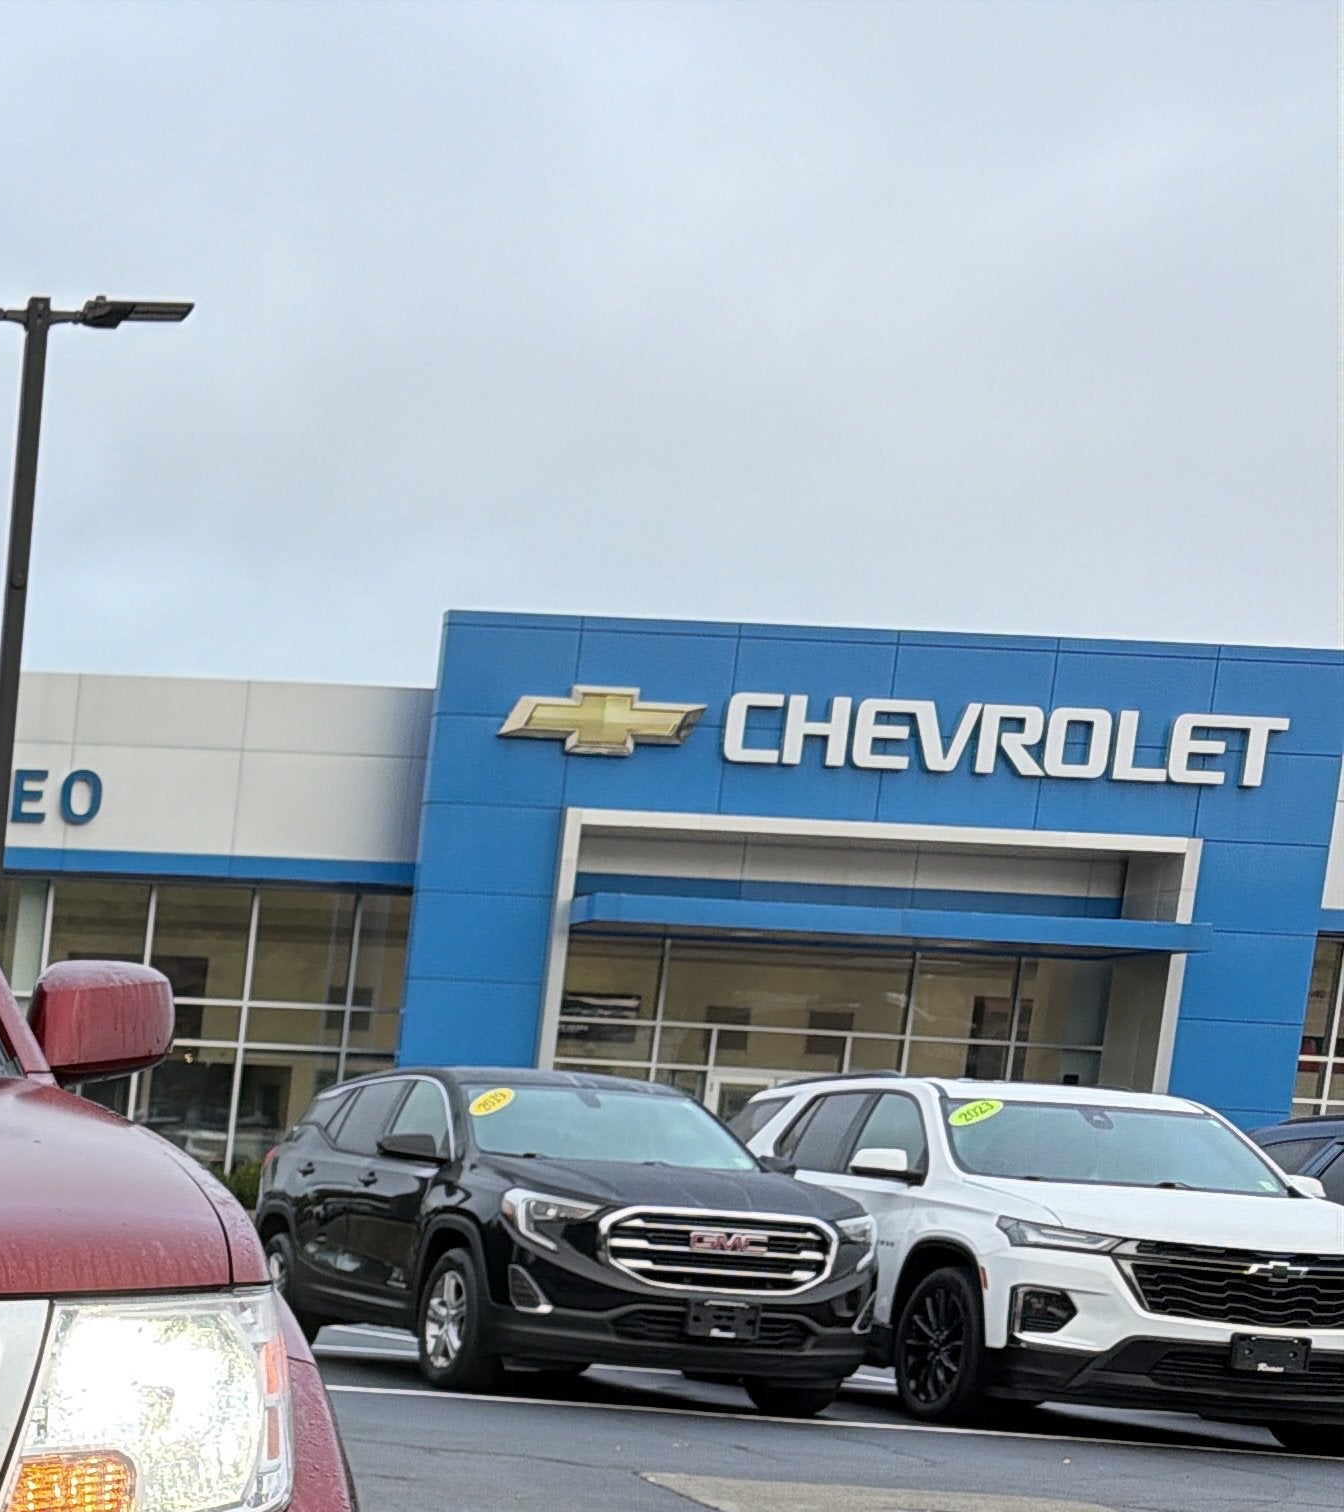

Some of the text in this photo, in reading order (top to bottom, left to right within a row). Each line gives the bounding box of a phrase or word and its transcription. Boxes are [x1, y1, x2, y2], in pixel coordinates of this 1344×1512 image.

[722, 691, 1291, 787] CHEVROLET
[958, 1101, 995, 1123] 2023
[689, 1231, 769, 1254] GMC
